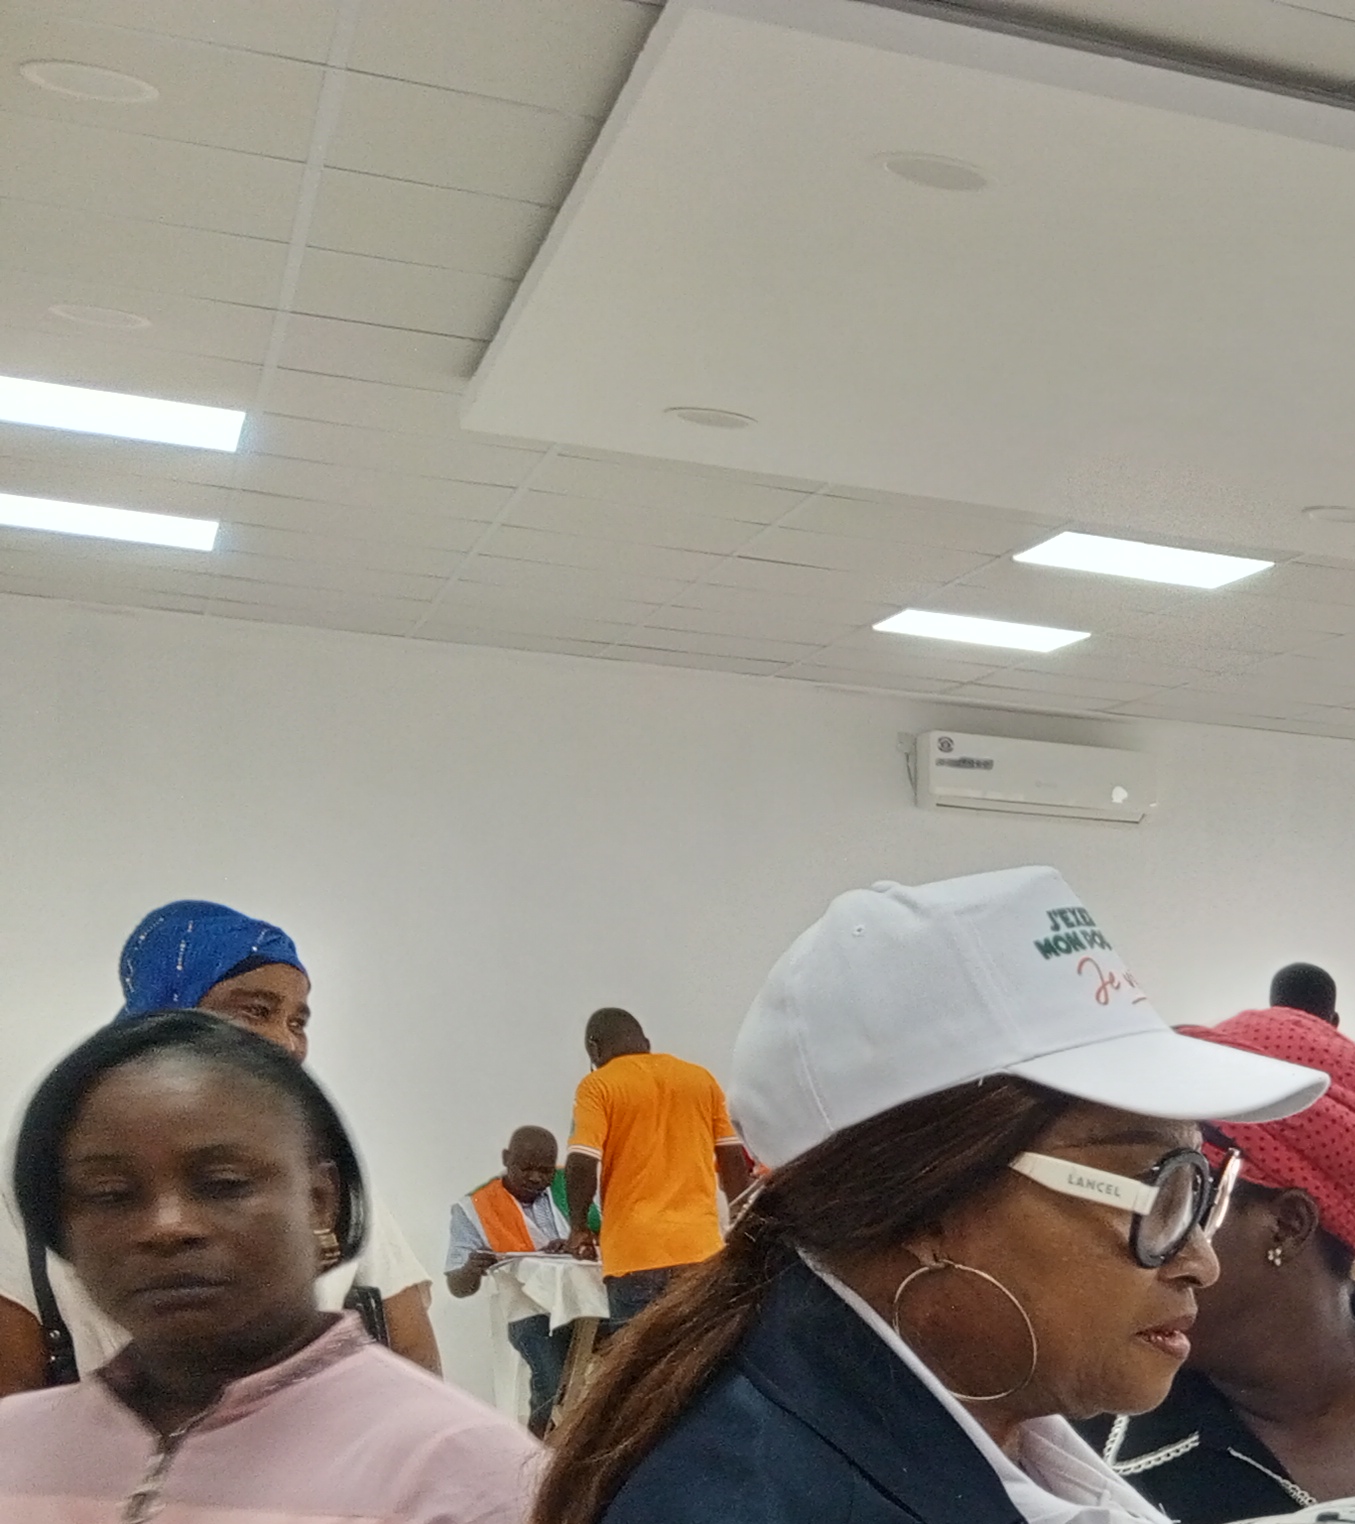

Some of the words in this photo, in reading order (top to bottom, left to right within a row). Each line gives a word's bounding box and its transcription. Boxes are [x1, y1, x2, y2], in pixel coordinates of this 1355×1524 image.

[1033, 930, 1087, 961] MON
[1077, 957, 1121, 1006] Je
[1066, 1173, 1121, 1198] LANCEL
